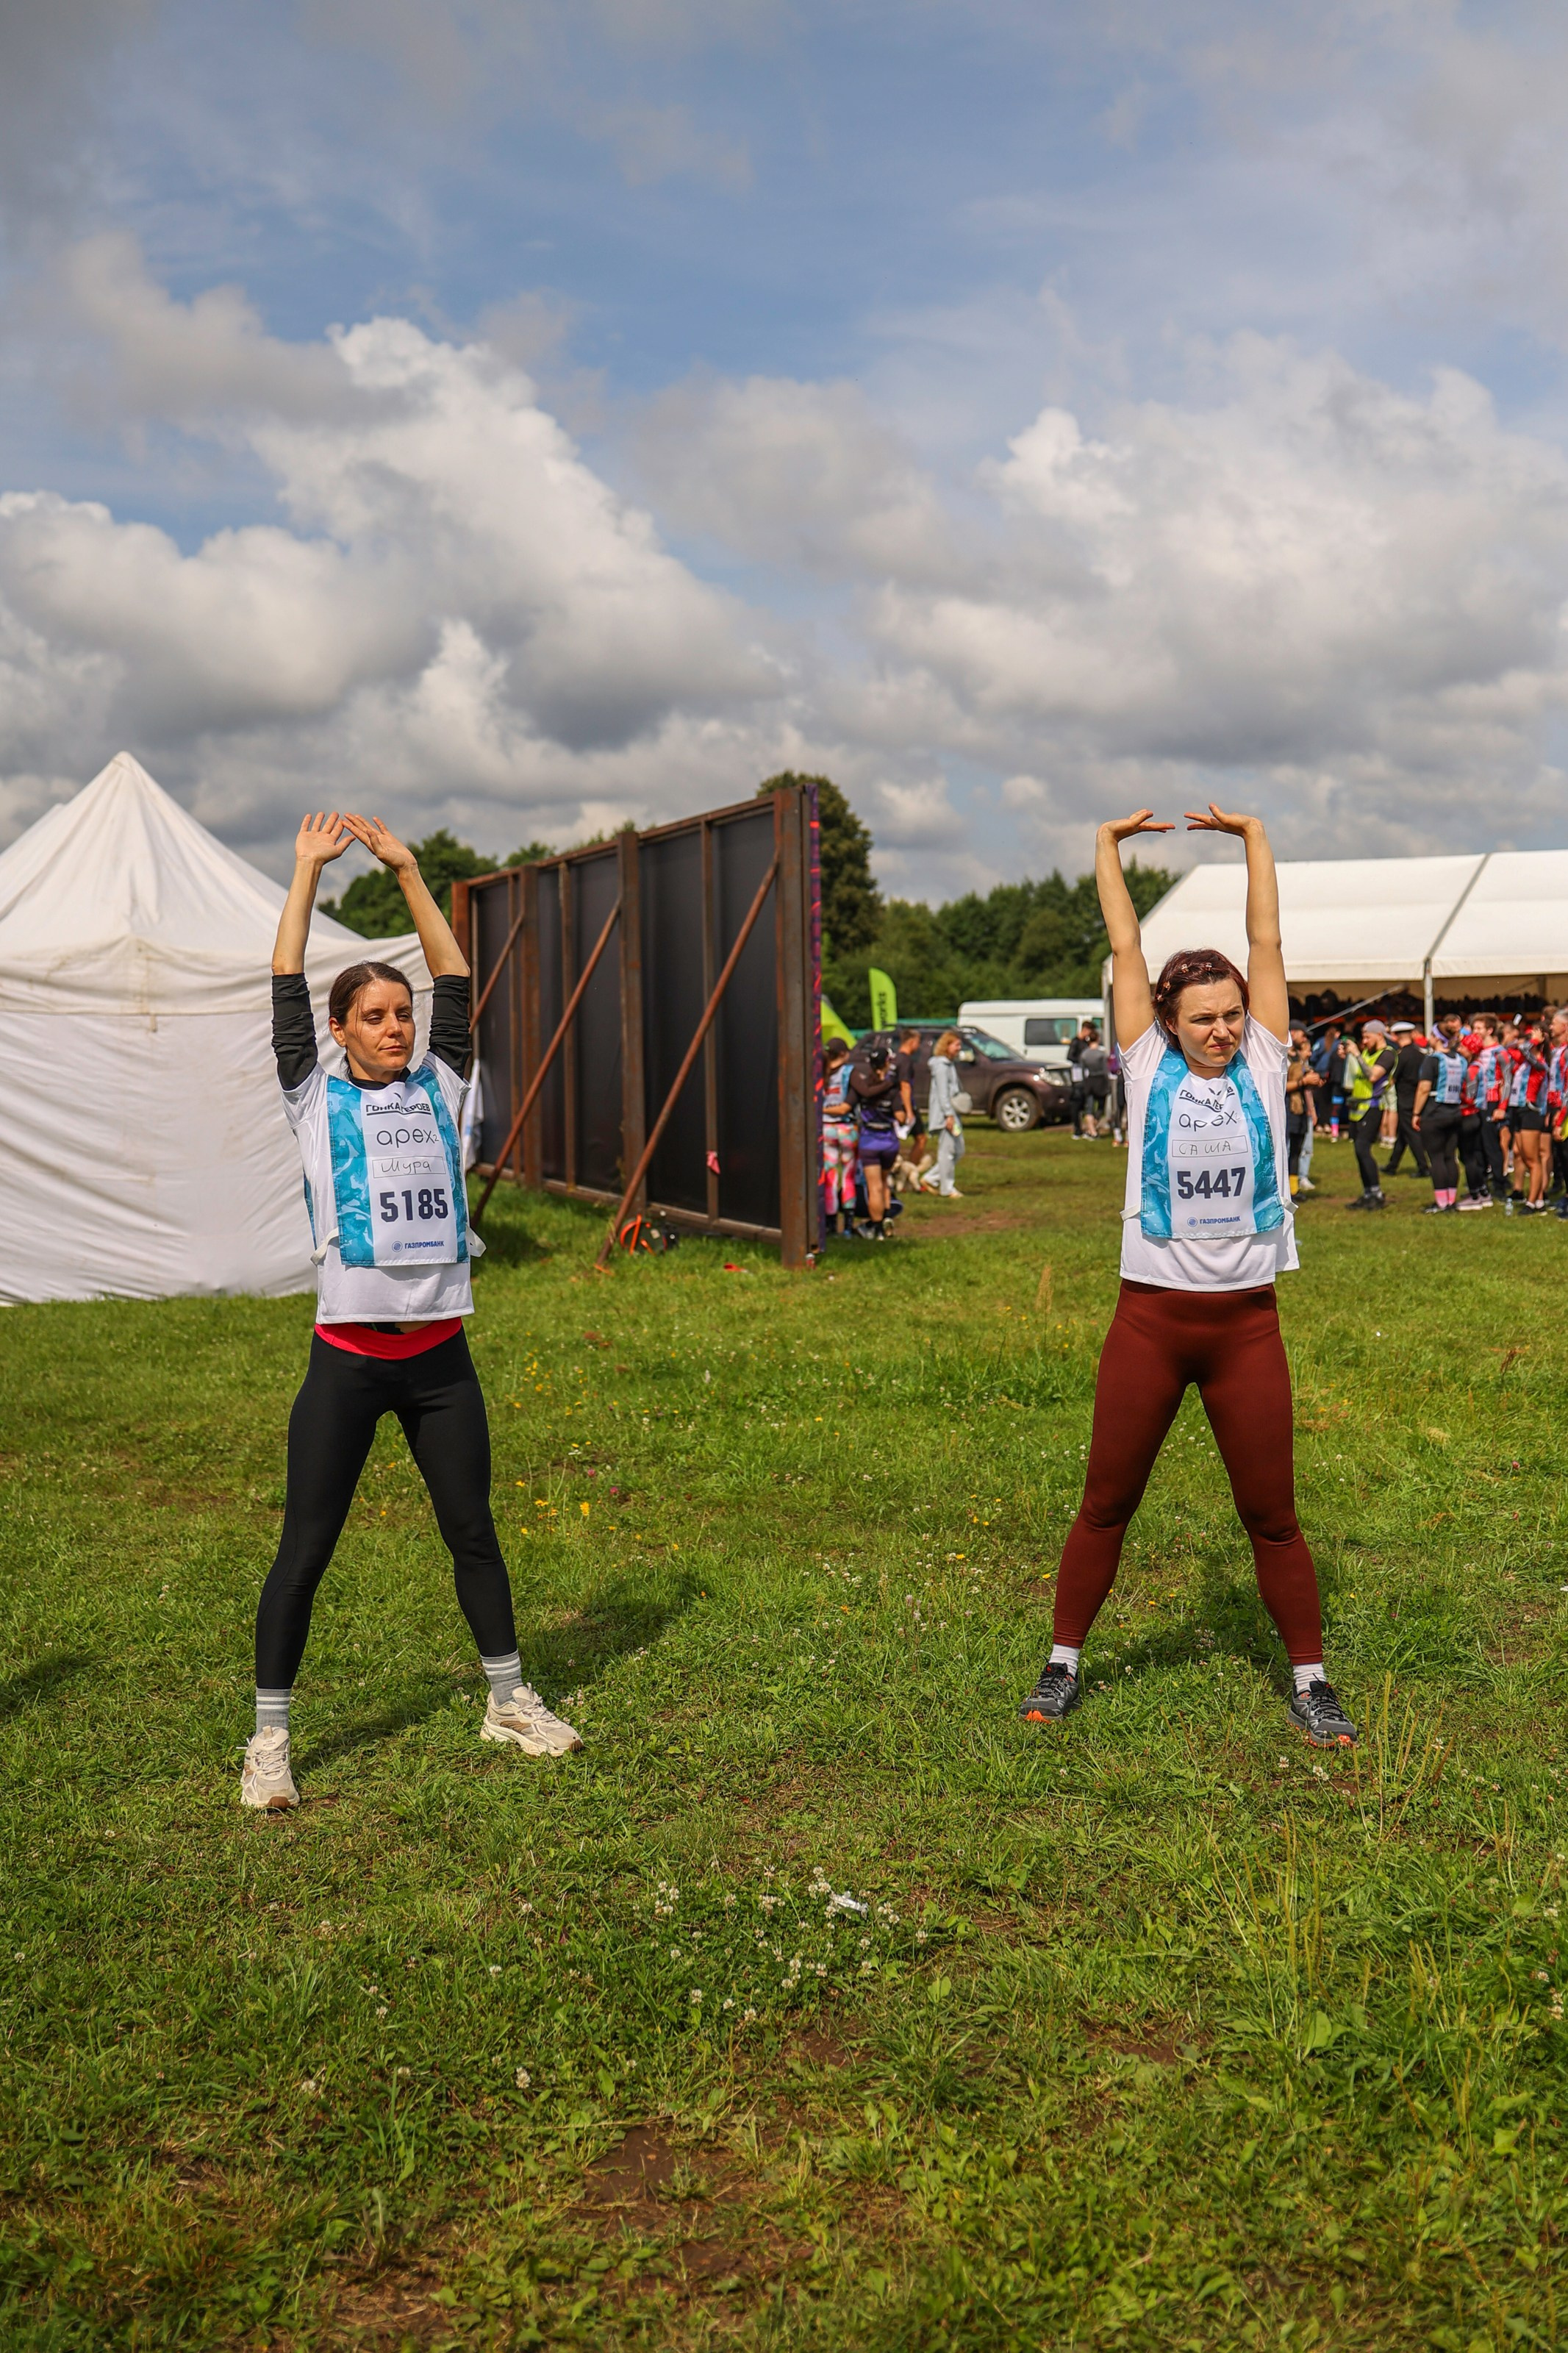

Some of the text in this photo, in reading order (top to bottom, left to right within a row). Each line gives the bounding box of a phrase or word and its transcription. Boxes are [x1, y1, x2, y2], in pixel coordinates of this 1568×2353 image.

[1179, 1089, 1211, 1105] ГОНКА
[365, 1102, 401, 1113] ГОНКА
[1176, 1166, 1246, 1200] 5447
[379, 1188, 448, 1223] 5185
[1199, 1215, 1241, 1225] ГАЗПРОМБАНК
[404, 1240, 445, 1249] ГАЗПРОМБАНК
